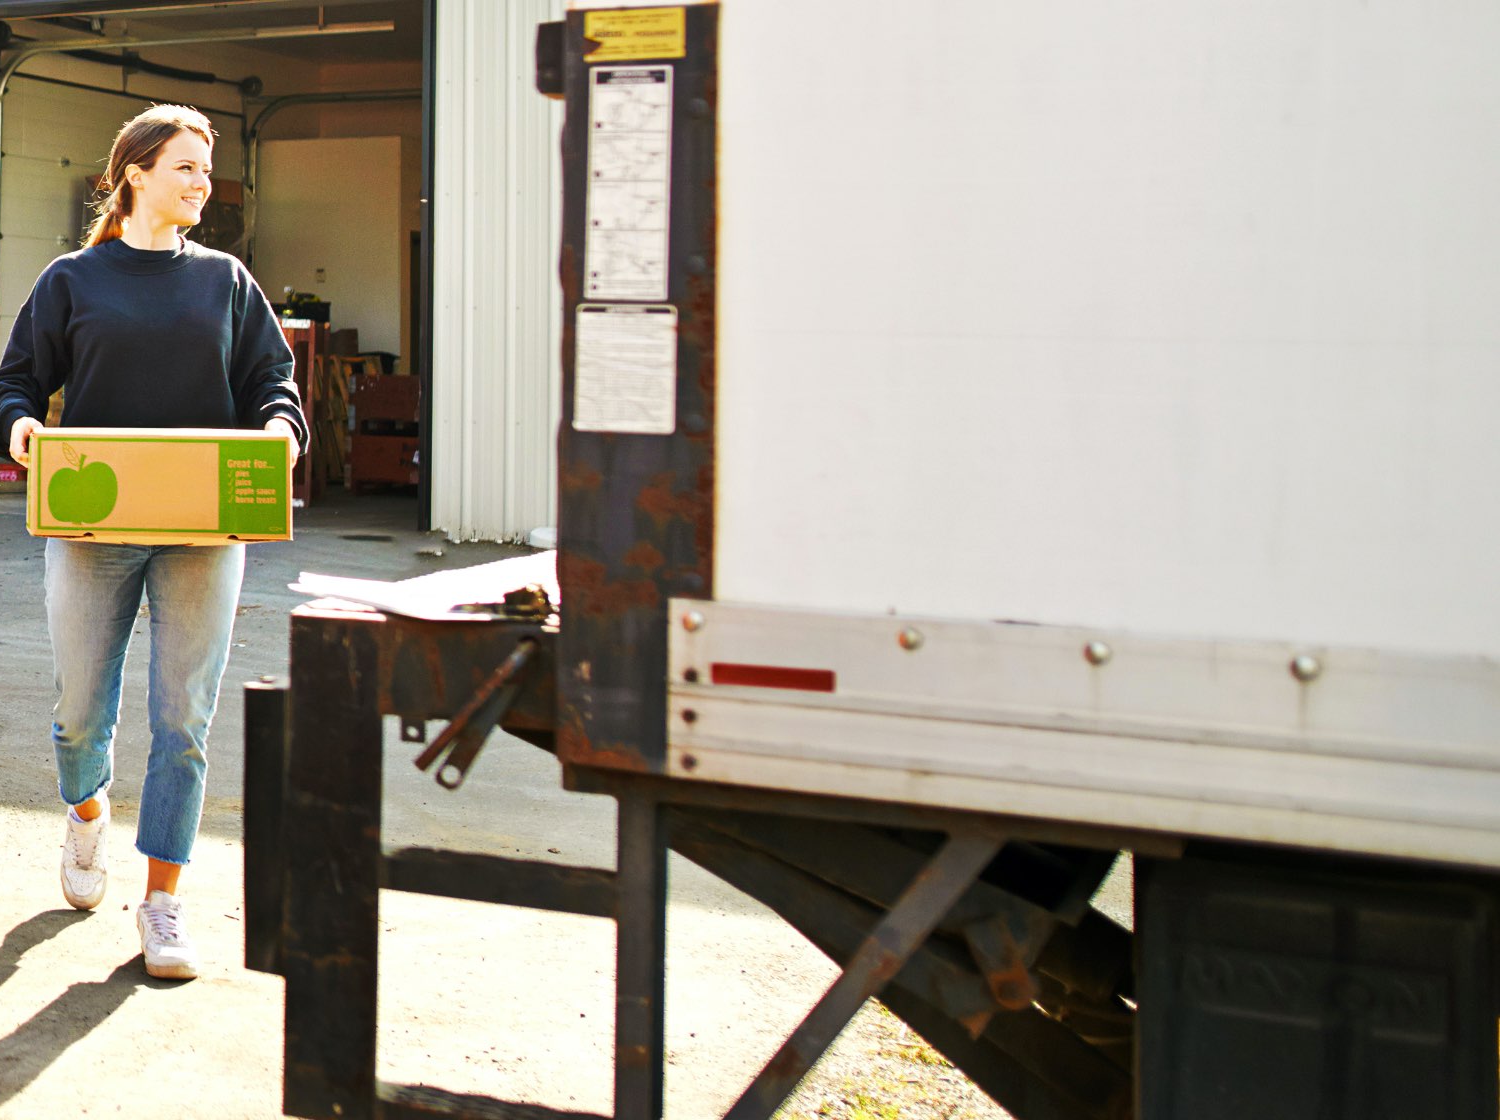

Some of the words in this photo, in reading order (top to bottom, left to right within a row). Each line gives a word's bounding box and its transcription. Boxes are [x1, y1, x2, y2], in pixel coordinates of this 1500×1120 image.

[227, 459, 251, 468] Great
[235, 470, 250, 478] pies
[235, 479, 252, 487] juice
[235, 488, 254, 496] apple
